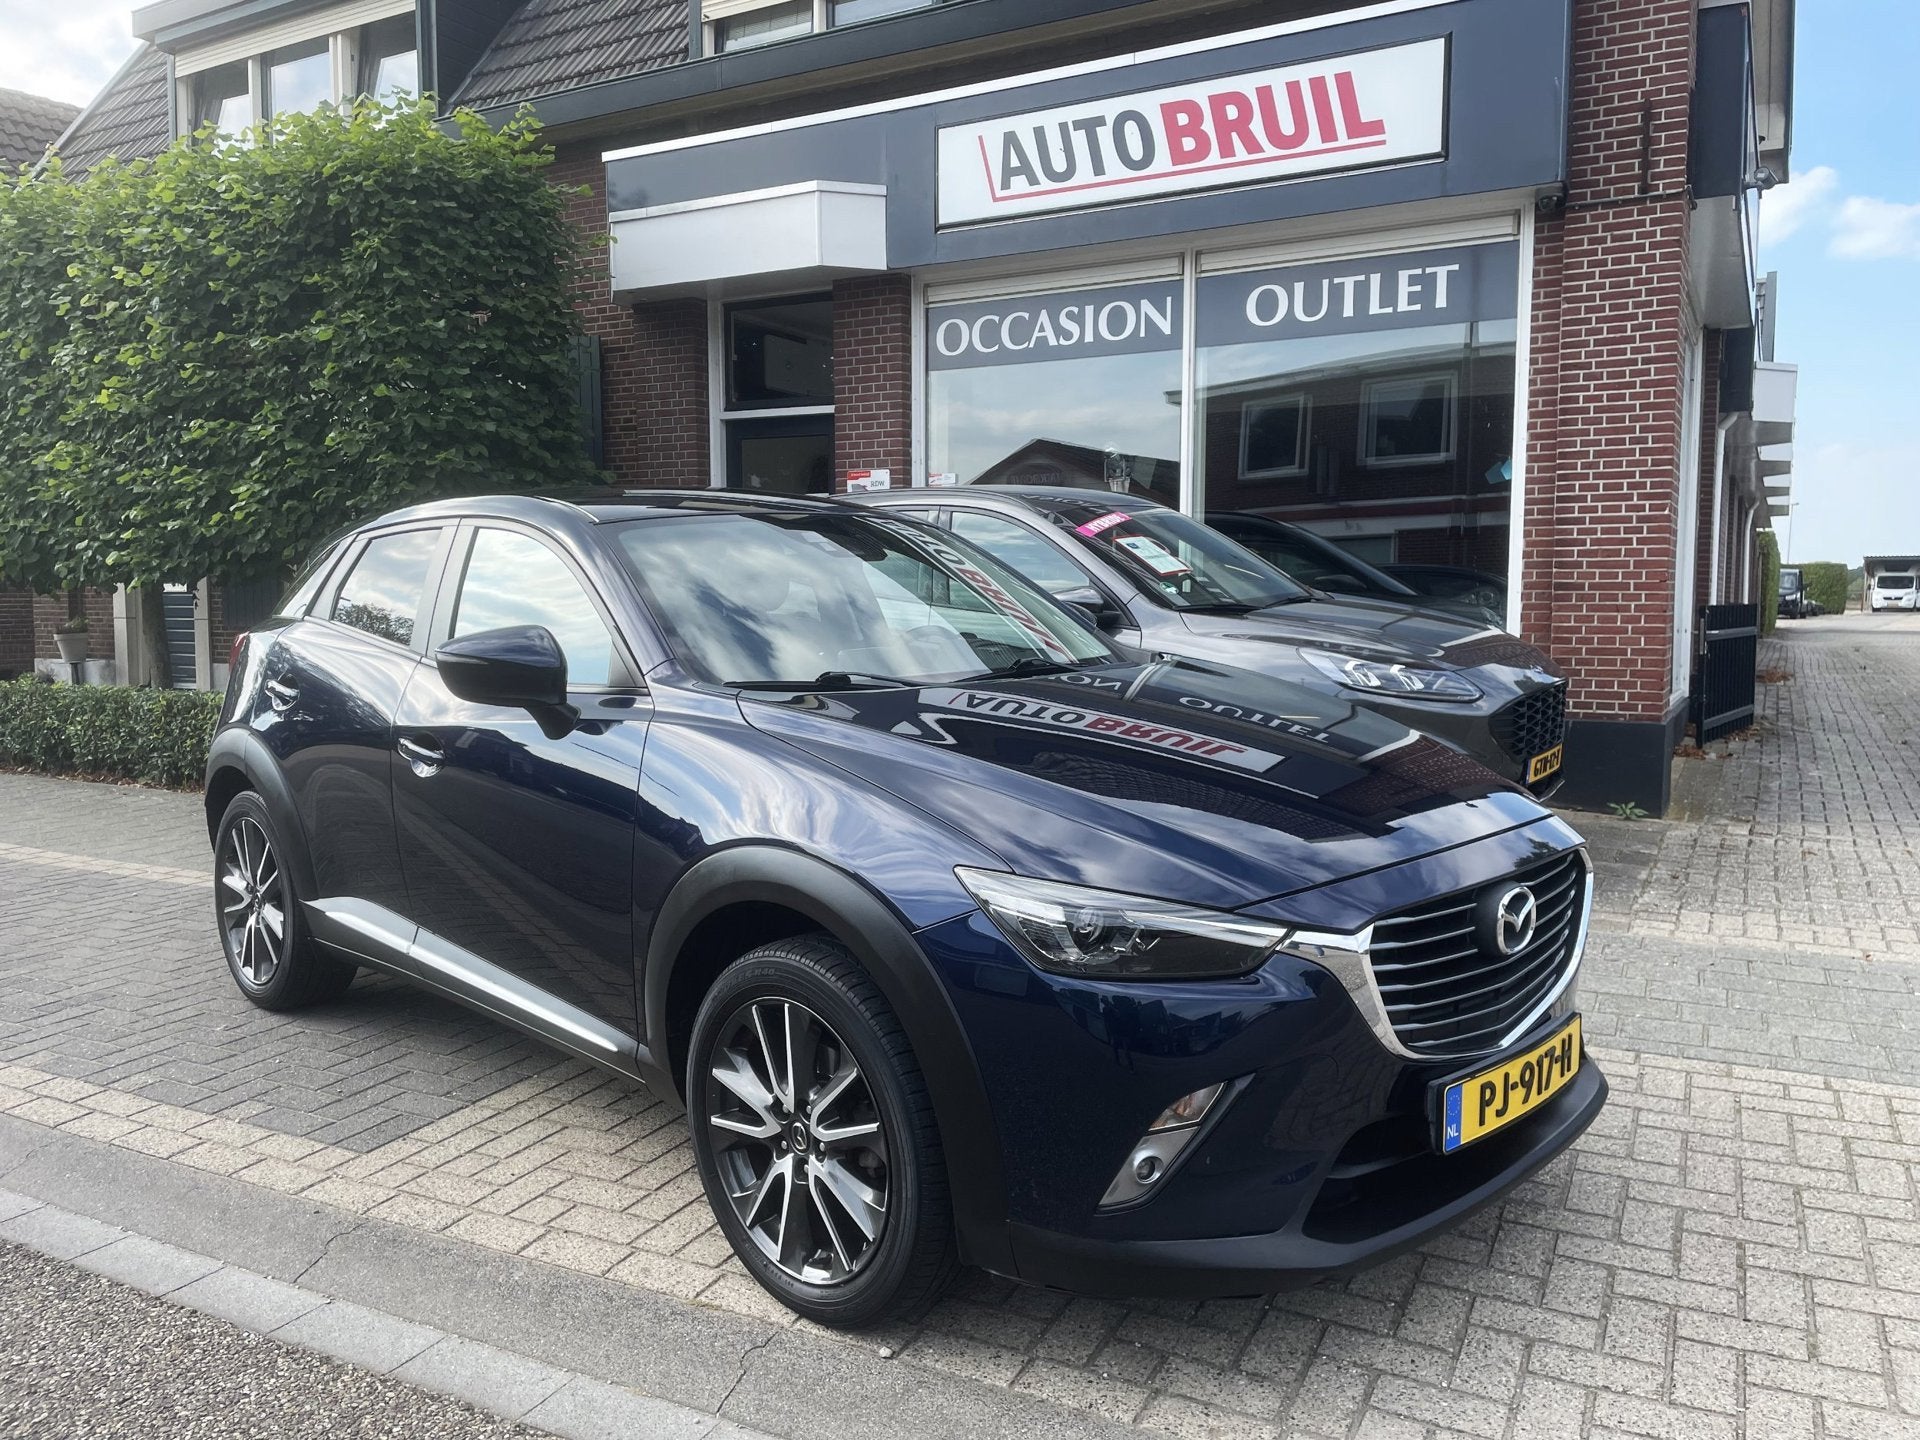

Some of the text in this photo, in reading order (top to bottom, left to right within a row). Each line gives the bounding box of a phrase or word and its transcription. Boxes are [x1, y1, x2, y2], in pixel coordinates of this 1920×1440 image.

[1000, 71, 1386, 191] AUTO BRUIL
[935, 263, 1459, 357] OCCASION OUTLET
[1478, 1033, 1573, 1127] PJ-917-H
[1447, 1124, 1459, 1139] NL
